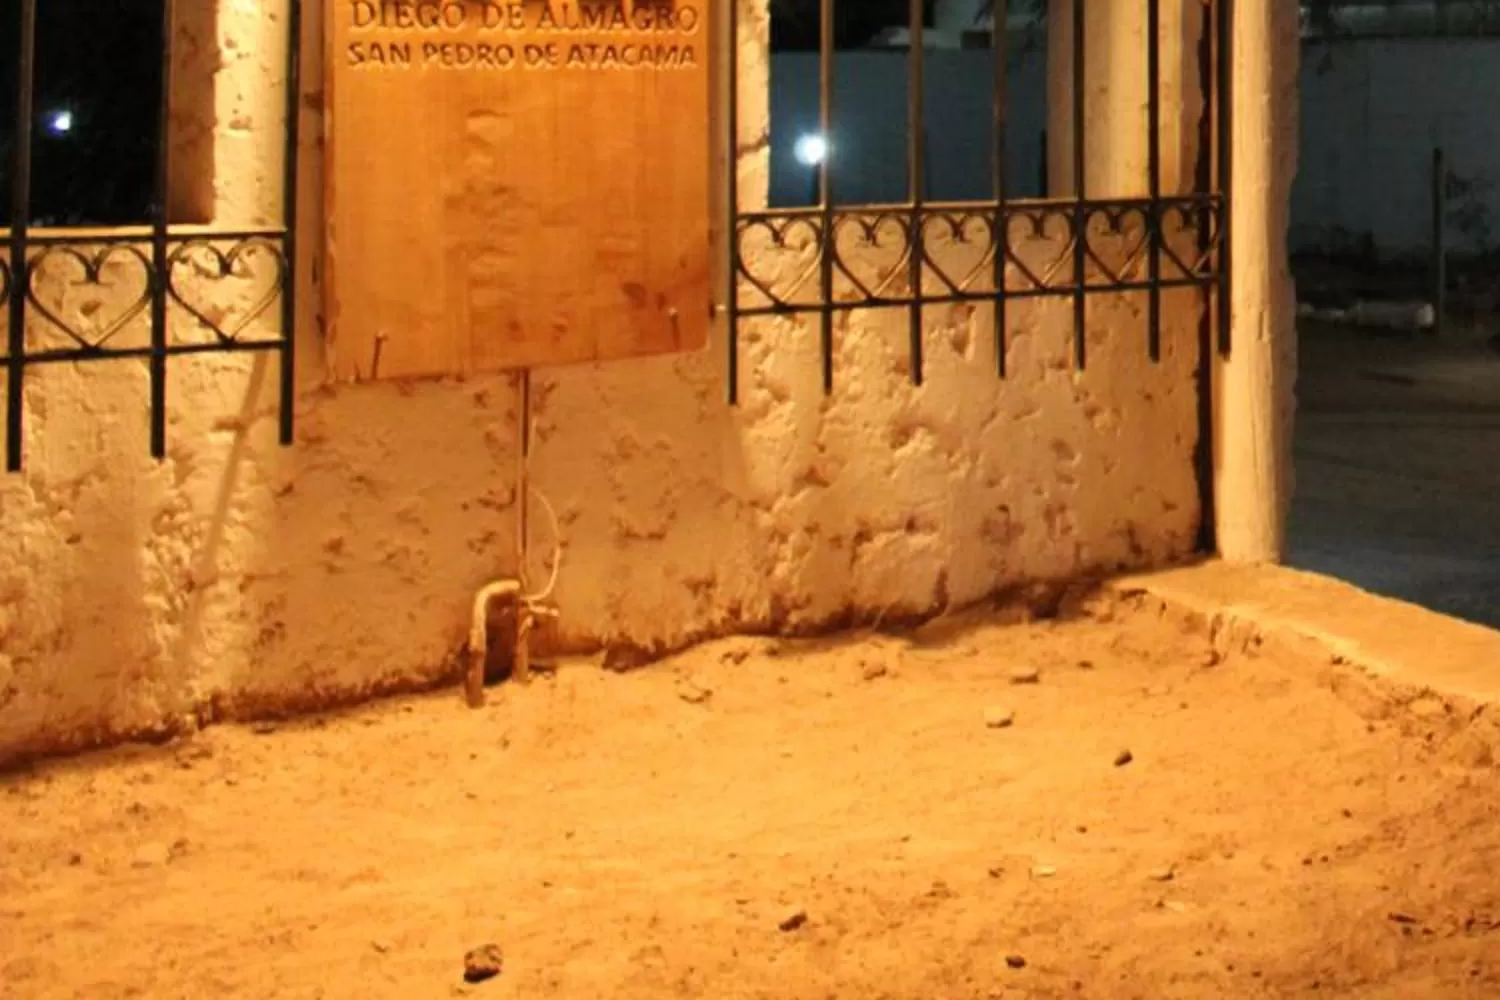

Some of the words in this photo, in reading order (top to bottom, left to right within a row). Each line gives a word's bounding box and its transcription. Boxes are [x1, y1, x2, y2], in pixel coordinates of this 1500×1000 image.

[481, 1, 526, 30] DE
[537, 2, 698, 32] ALMAGRO
[348, 40, 411, 66] SAN
[422, 41, 515, 67] PEDRO
[523, 43, 557, 66] DE
[567, 42, 697, 67] ATACAMA
